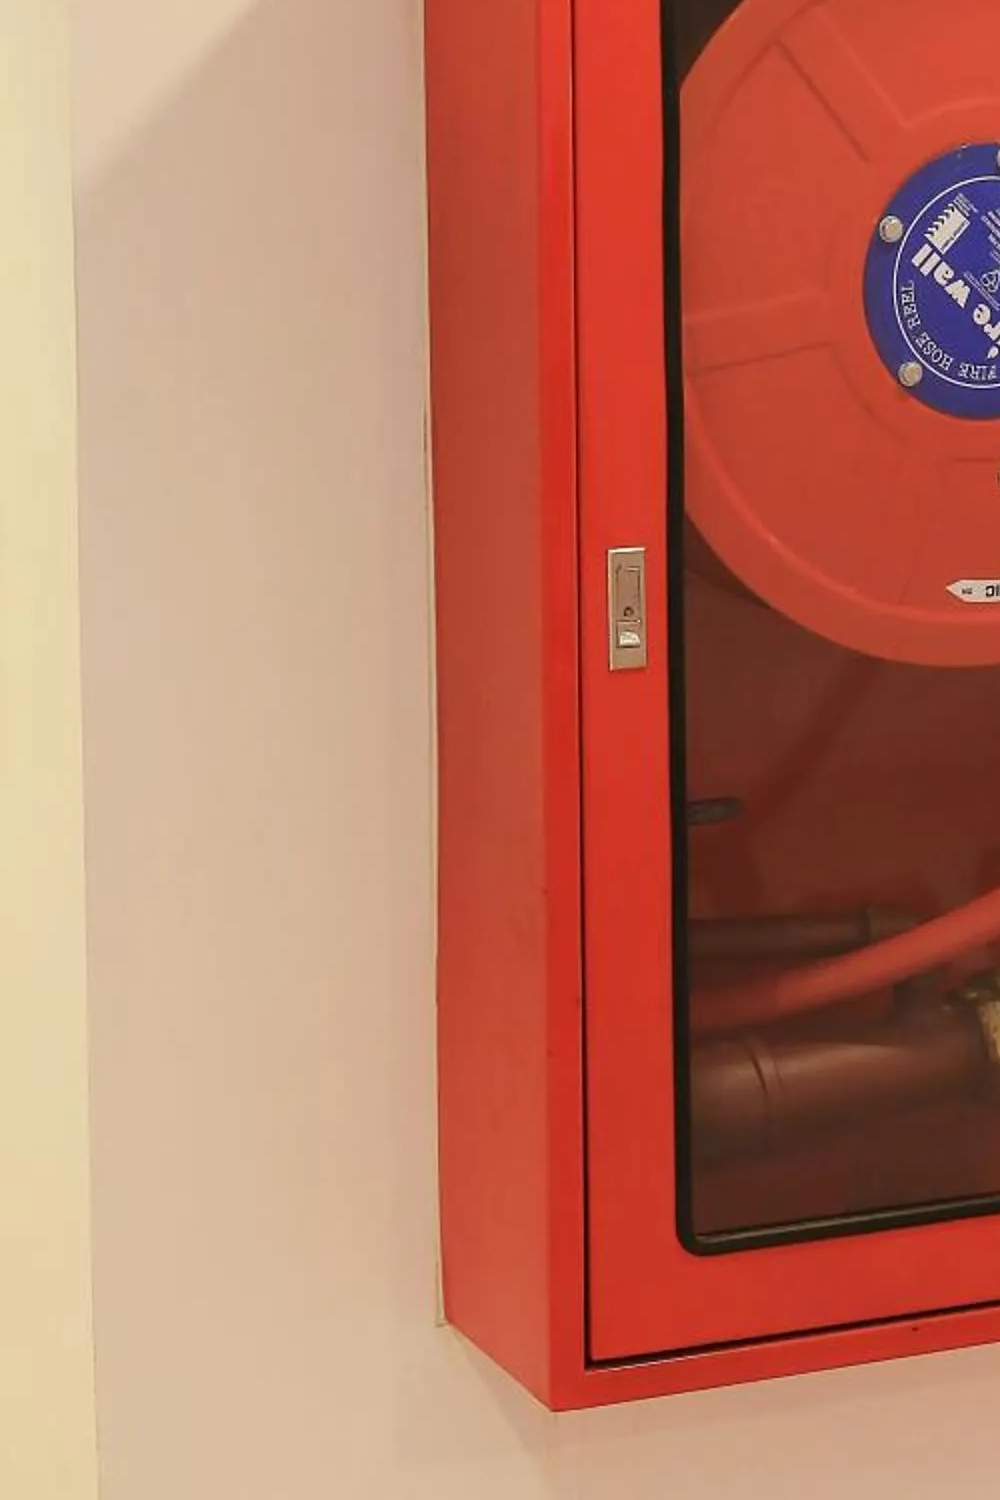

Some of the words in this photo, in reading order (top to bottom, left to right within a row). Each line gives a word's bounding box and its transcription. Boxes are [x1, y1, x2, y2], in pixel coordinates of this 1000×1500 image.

[912, 244, 970, 308] wall
[901, 280, 921, 330] REEL
[915, 331, 954, 371] HOSE
[957, 362, 997, 380] FIRE
